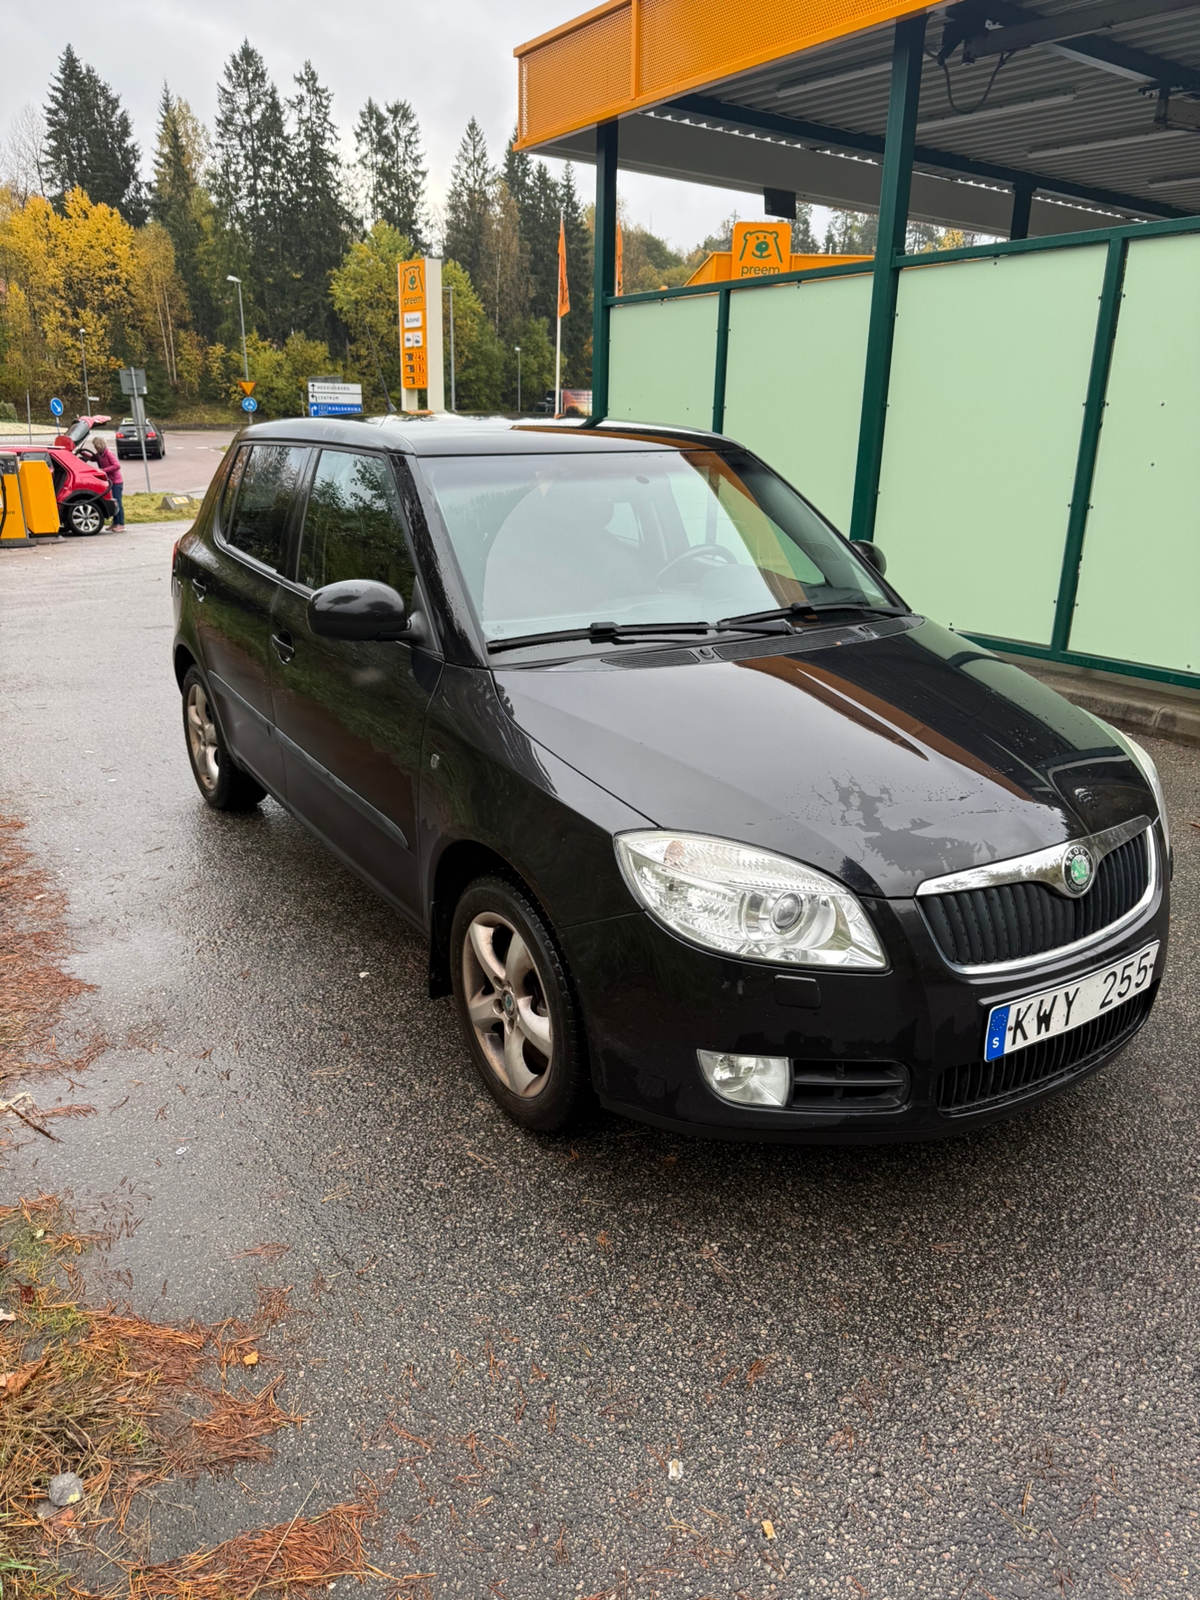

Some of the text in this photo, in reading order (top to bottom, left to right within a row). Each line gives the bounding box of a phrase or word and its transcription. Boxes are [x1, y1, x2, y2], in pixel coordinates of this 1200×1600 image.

[741, 265, 780, 277] preem
[404, 296, 423, 308] preem
[1011, 951, 1151, 1046] KWY 255
[992, 1037, 1000, 1048] S
